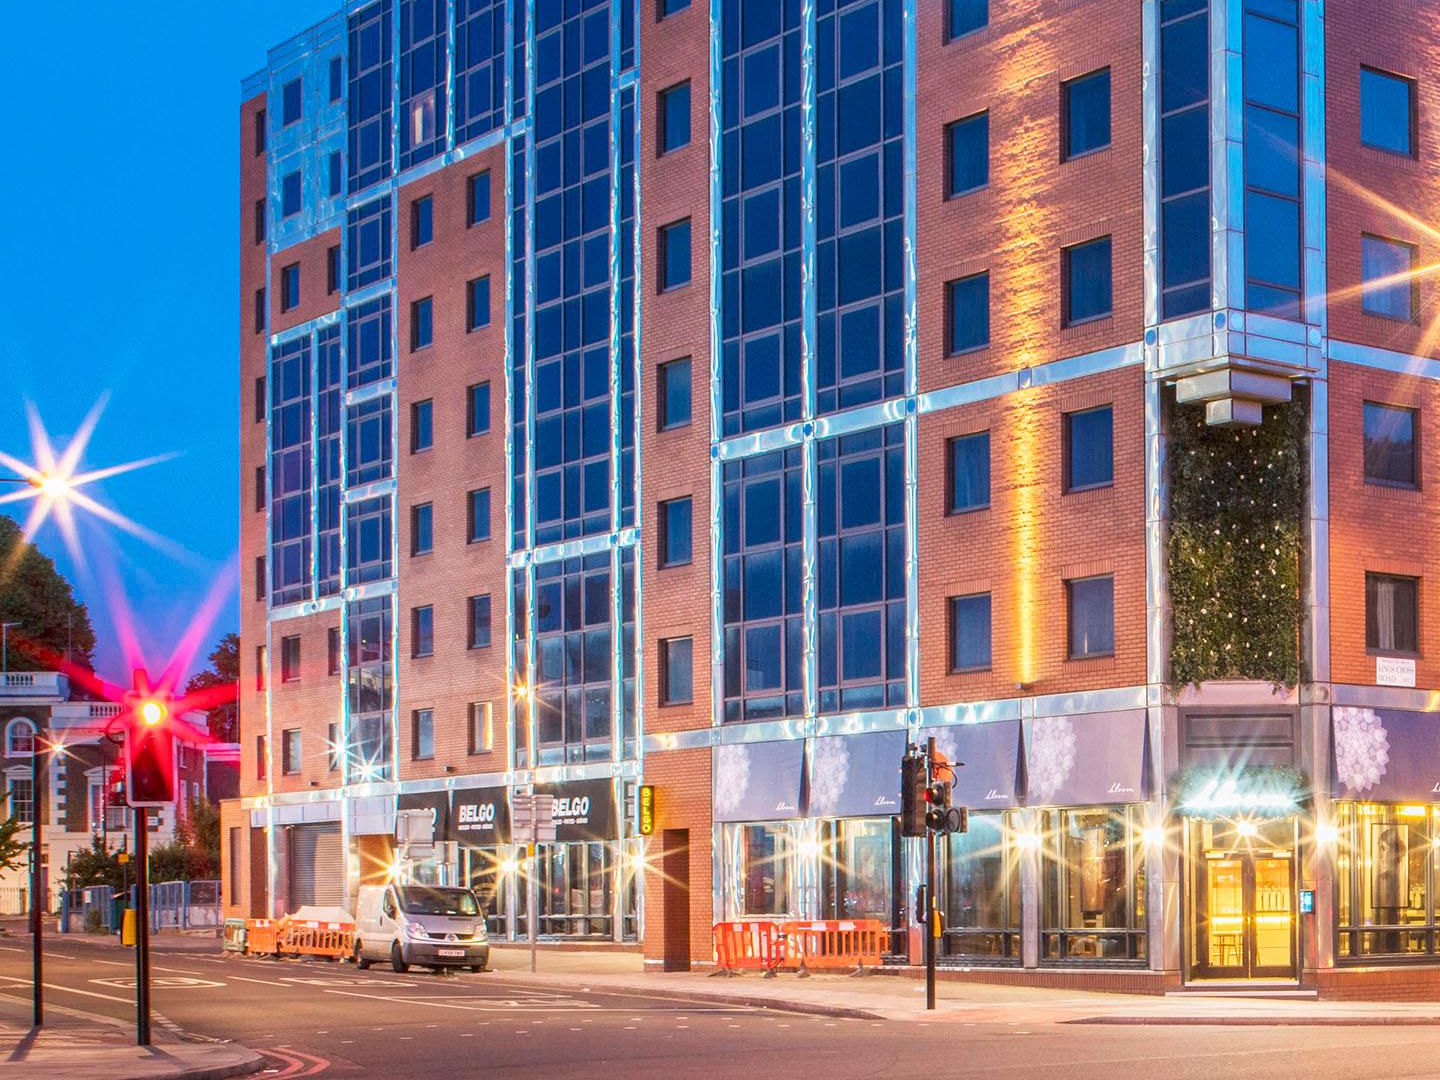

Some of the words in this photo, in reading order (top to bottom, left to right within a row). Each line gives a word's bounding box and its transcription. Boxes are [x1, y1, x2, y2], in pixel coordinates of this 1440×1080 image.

[458, 803, 495, 822] BELGO
[552, 796, 590, 817] BELGO
[641, 786, 652, 834] BELGO
